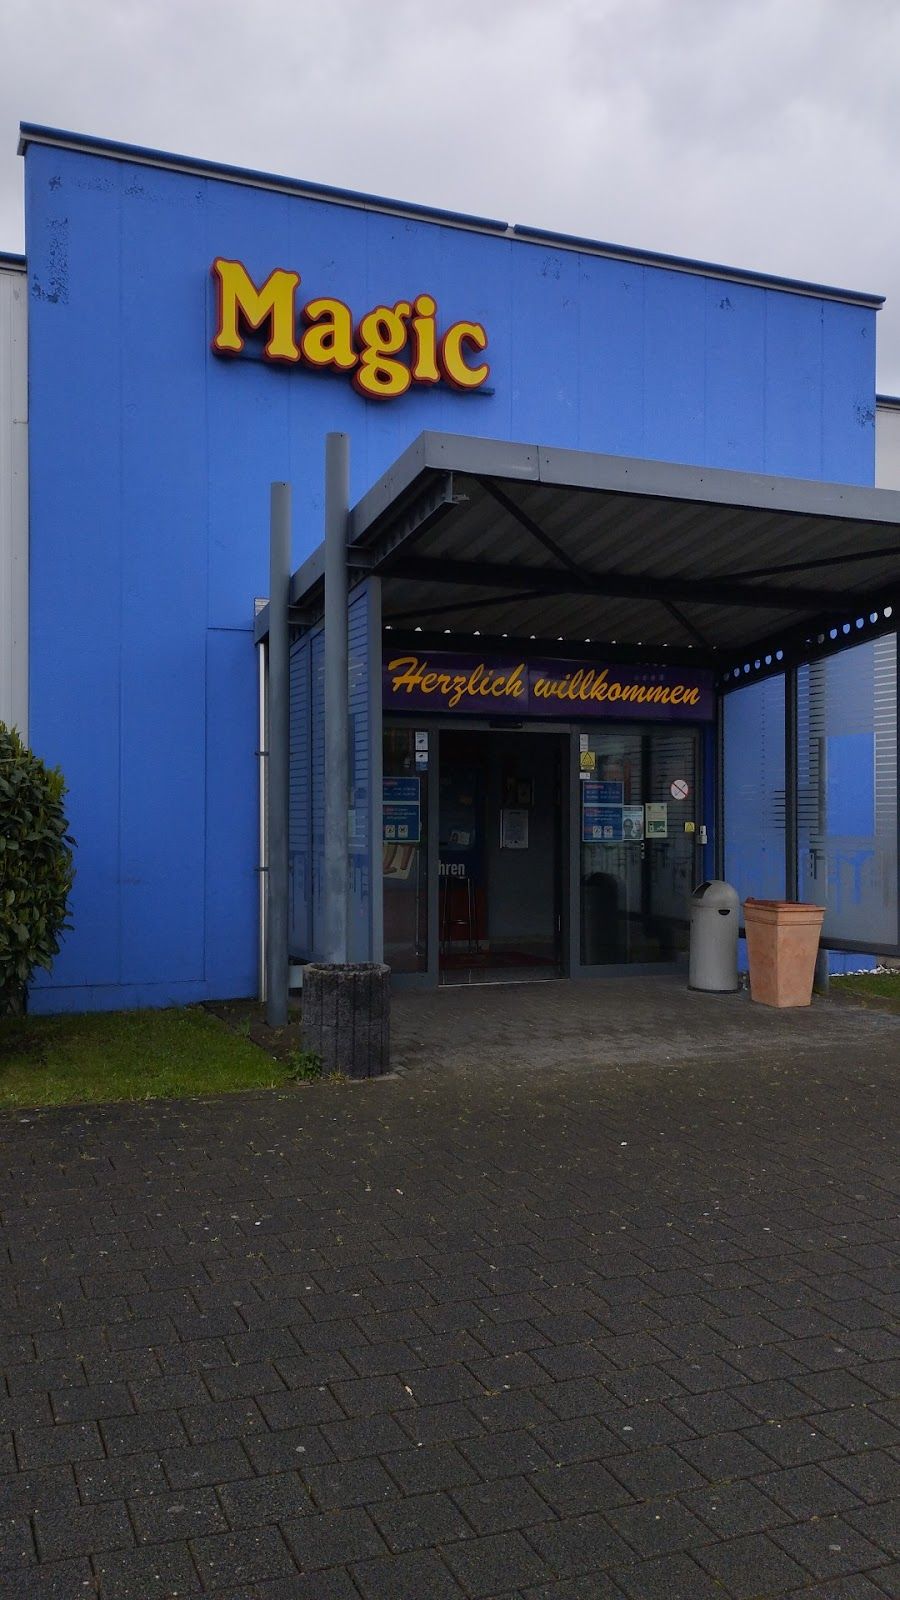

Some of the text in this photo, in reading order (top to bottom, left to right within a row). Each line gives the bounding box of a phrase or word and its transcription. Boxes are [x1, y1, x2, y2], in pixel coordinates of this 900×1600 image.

[211, 257, 490, 399] Magic
[388, 657, 700, 707] Herzlich willkommen
